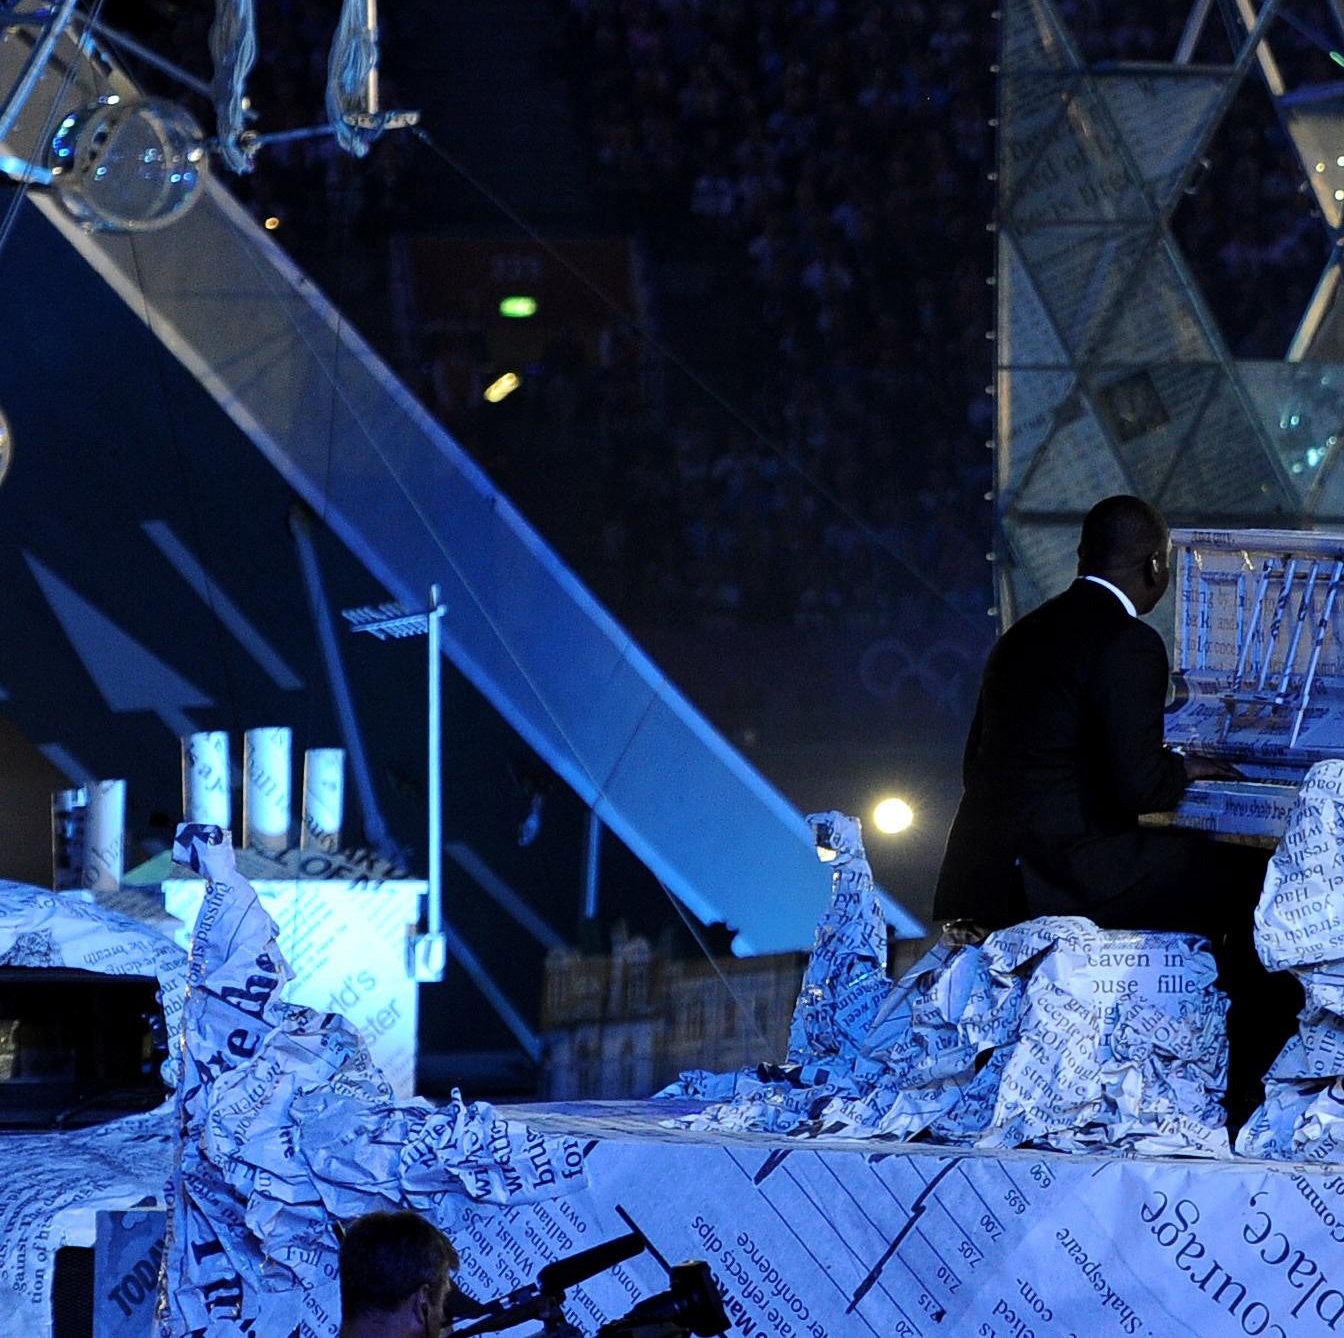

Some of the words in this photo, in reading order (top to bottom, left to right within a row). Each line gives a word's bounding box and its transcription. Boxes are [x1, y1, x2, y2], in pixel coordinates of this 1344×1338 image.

[195, 881, 232, 945] passing
[1273, 886, 1309, 907] Had
[1164, 953, 1185, 968] in
[1157, 974, 1200, 996] fille
[562, 1140, 584, 1179] for
[1029, 1164, 1052, 1189] 6.90
[559, 1201, 587, 1234] own
[1003, 1189, 1026, 1215] 6.95
[691, 1216, 723, 1253] dips
[980, 1214, 1003, 1243] 7.00
[495, 1220, 534, 1277] Whilst,
[957, 1240, 982, 1269] 7.05
[452, 1245, 494, 1289] safety
[719, 1250, 770, 1311] reflects
[736, 1232, 810, 1321] confidence
[936, 1266, 960, 1295] 7.10
[1055, 1228, 1143, 1335] Shakespeare
[1016, 1278, 1053, 1322] com-
